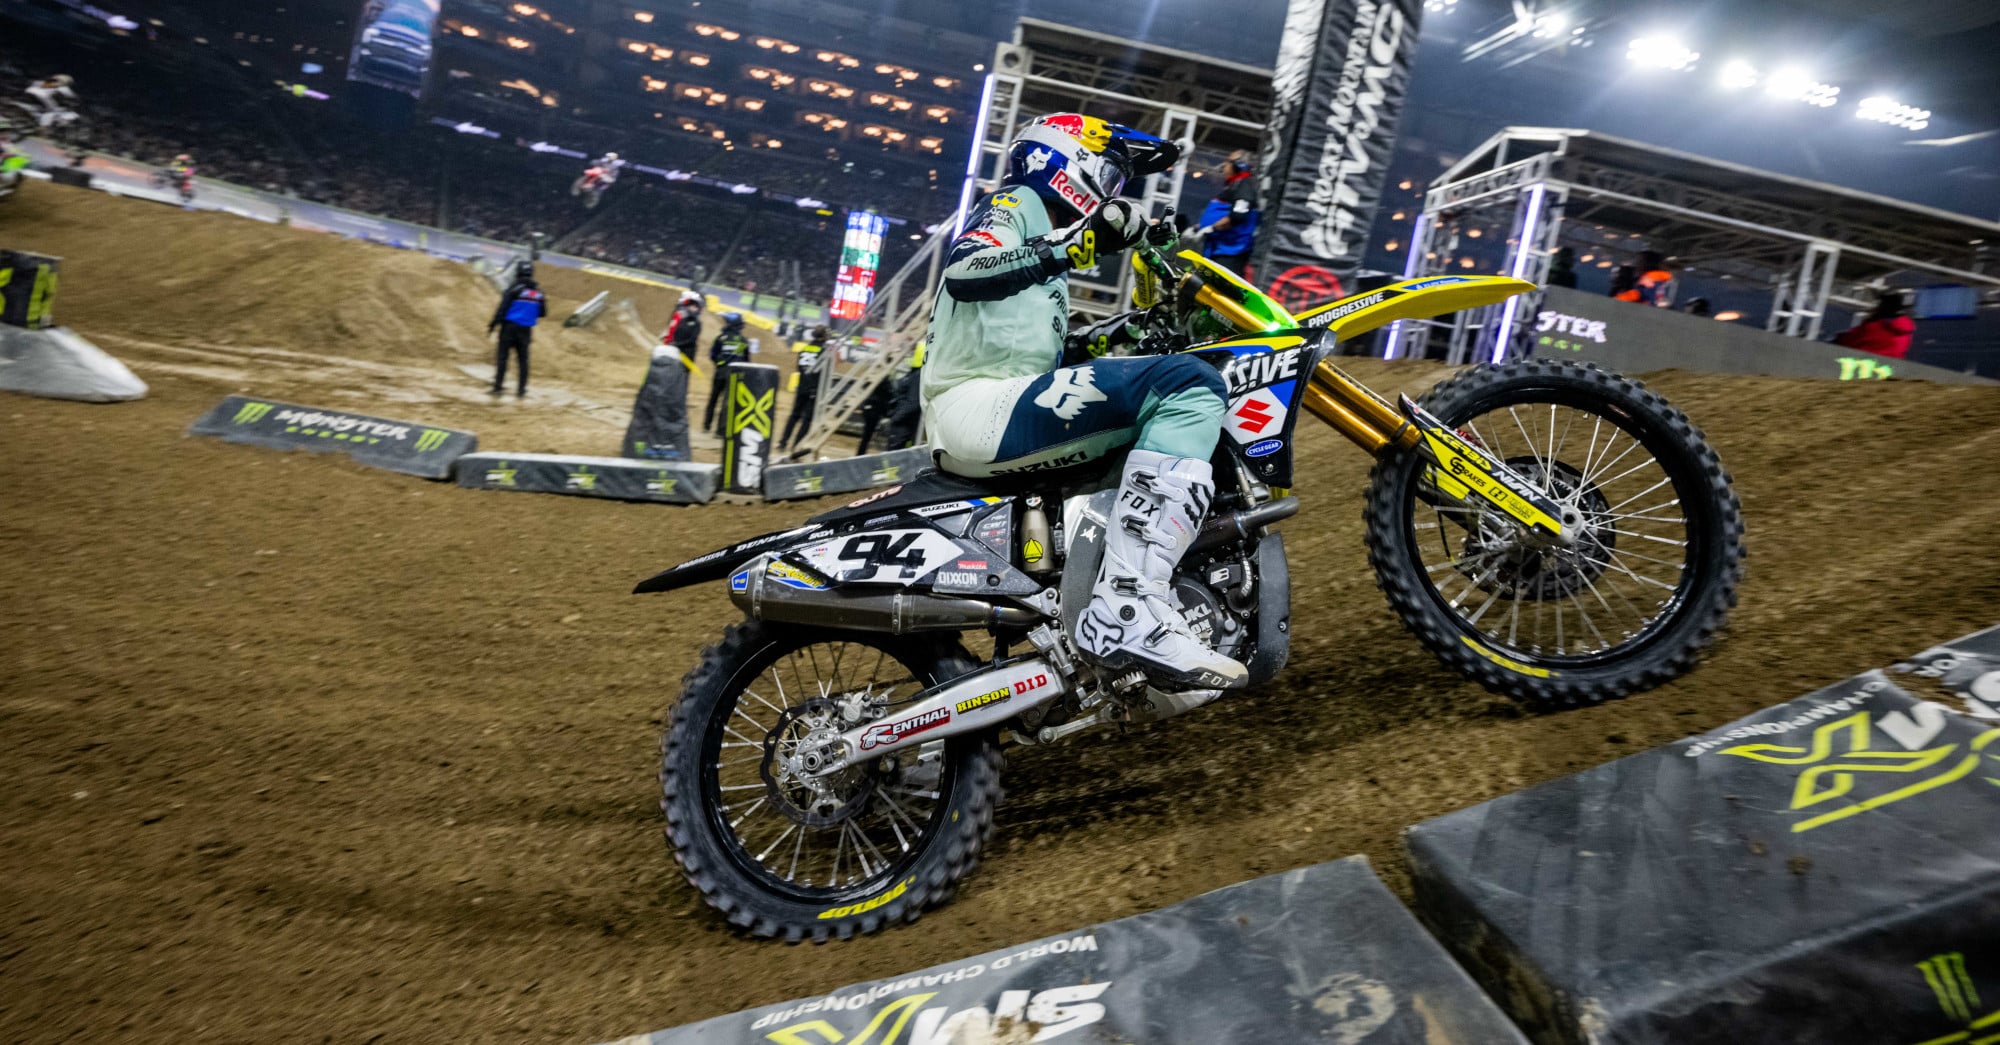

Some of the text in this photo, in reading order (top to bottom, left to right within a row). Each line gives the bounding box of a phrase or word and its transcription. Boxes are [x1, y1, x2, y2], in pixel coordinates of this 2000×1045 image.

[1308, 290, 1384, 328] PROGRESSIVE
[920, 502, 960, 514] SUZUKI
[1120, 490, 1160, 518] FOX
[834, 533, 928, 582] 94
[938, 572, 978, 585] DIXXON
[1199, 671, 1234, 688] FOX
[956, 687, 1011, 714] HINSON
[751, 935, 1098, 1031] WORLD CHAMPIONSHIP
